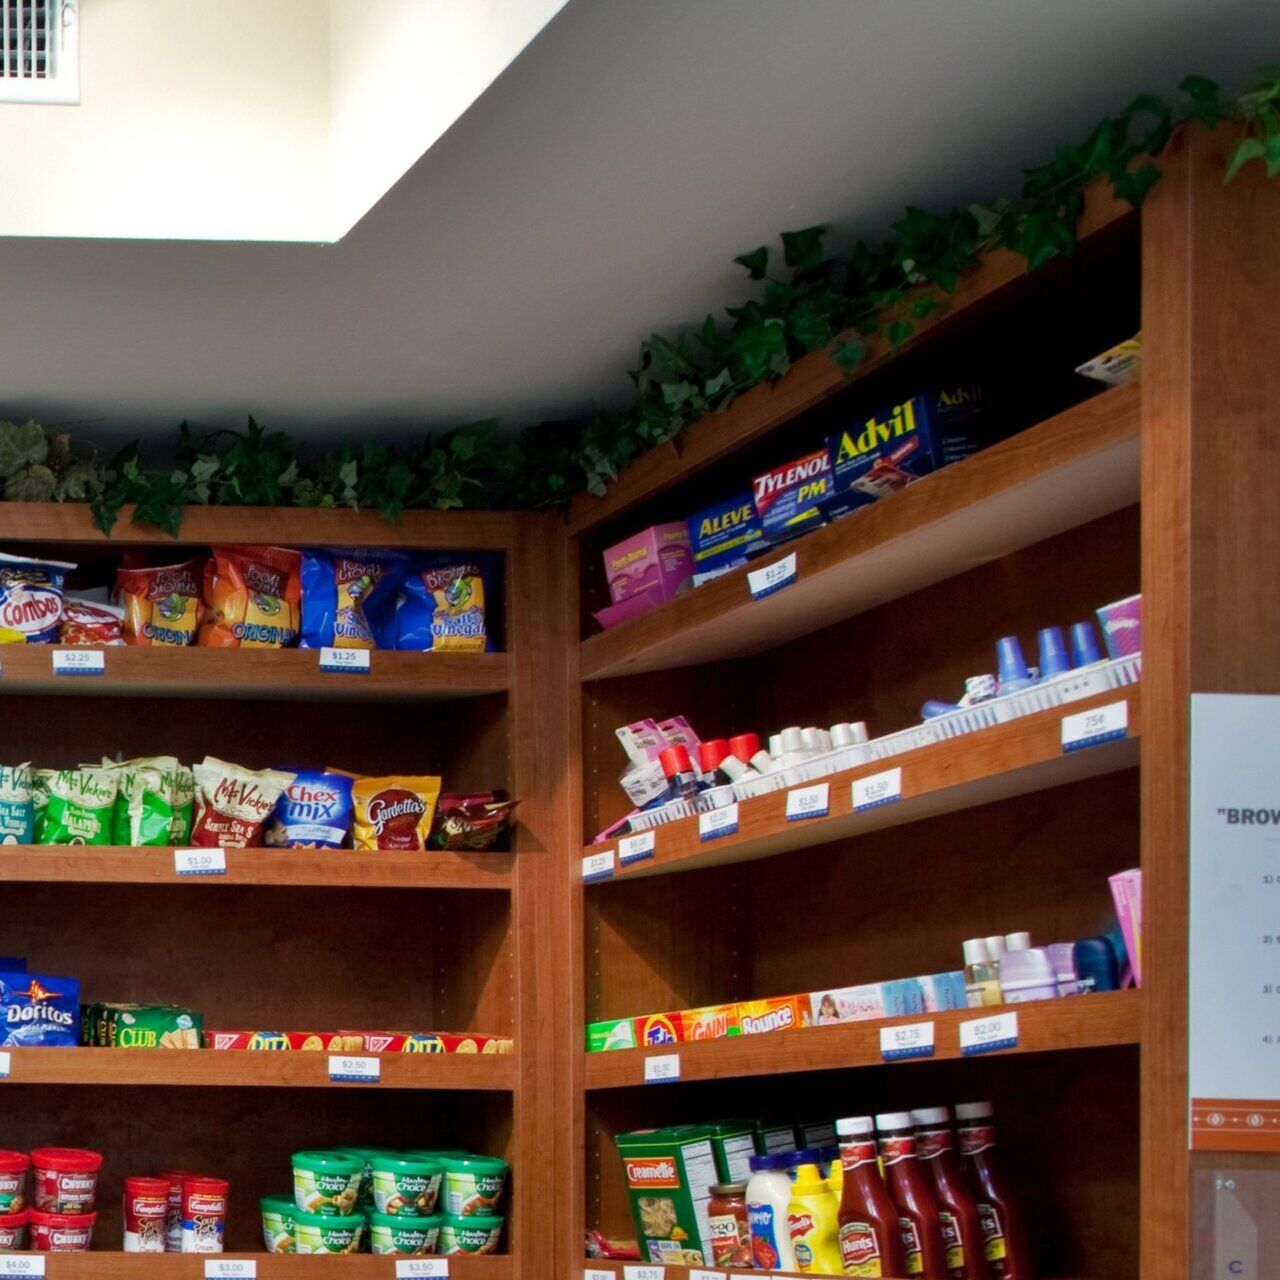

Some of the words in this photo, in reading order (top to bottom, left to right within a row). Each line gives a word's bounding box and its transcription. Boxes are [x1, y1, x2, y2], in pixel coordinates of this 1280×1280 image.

[937, 387, 983, 407] Advil
[835, 398, 916, 464] Advil
[755, 455, 830, 497] TYLENOL
[797, 479, 827, 503] PM
[699, 504, 752, 538] ALEVE
[765, 563, 787, 580] $1.25
[2, 594, 60, 627] Combos
[65, 653, 90, 662] $2.25
[332, 651, 356, 661] $1.25
[1085, 714, 1105, 728] 75¢
[239, 783, 275, 813] Vickie's
[288, 785, 336, 802] Chex
[290, 801, 335, 821] mix
[366, 798, 426, 836] Gardetto's
[7, 1003, 74, 1026] Doritos
[741, 1005, 793, 1036] Bounce
[119, 1027, 158, 1048] CLUB
[691, 1017, 728, 1042] GAIN
[974, 1021, 1001, 1037] $2.00
[342, 1060, 366, 1070] $2.50
[627, 1163, 676, 1182] Creamette
[60, 1178, 95, 1191] CHUNKY
[316, 1181, 346, 1193] Choice
[397, 1181, 427, 1193] Choice
[53, 1233, 87, 1246] CHUNKY
[323, 1235, 352, 1247] Choice
[393, 1235, 424, 1247] Choice
[456, 1235, 487, 1247] Choice
[842, 1237, 874, 1254] Hunt's
[6, 1260, 30, 1270] $4.00
[219, 1263, 243, 1273] $3.00
[409, 1262, 434, 1273] $3.50
